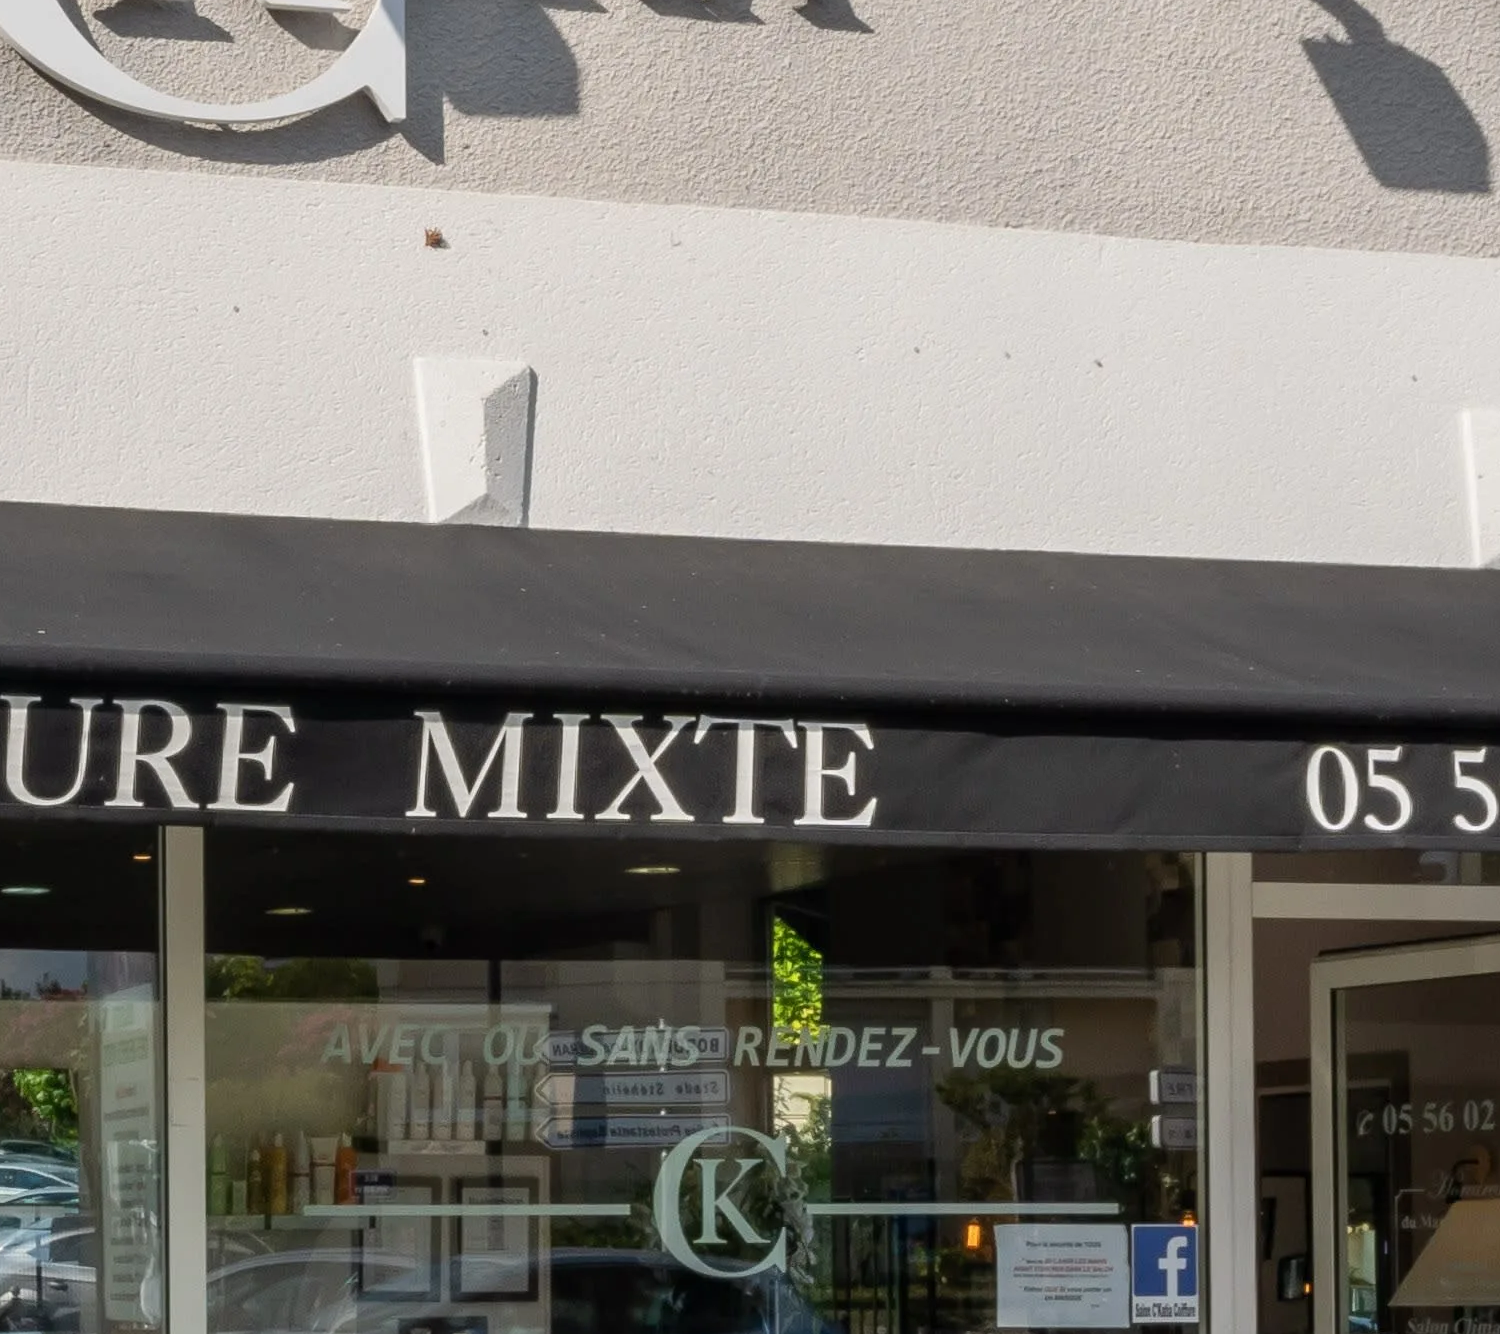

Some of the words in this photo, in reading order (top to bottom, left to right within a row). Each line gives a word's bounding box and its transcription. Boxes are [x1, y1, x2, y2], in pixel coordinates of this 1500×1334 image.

[404, 708, 879, 828] MIXTE
[1305, 746, 1414, 834] 05
[321, 1023, 449, 1066] AVEC
[482, 1024, 551, 1066] OU
[576, 1024, 701, 1067] SANS
[1382, 1104, 1414, 1135] 05
[1422, 1102, 1454, 1133] 56
[1463, 1099, 1496, 1131] 02
